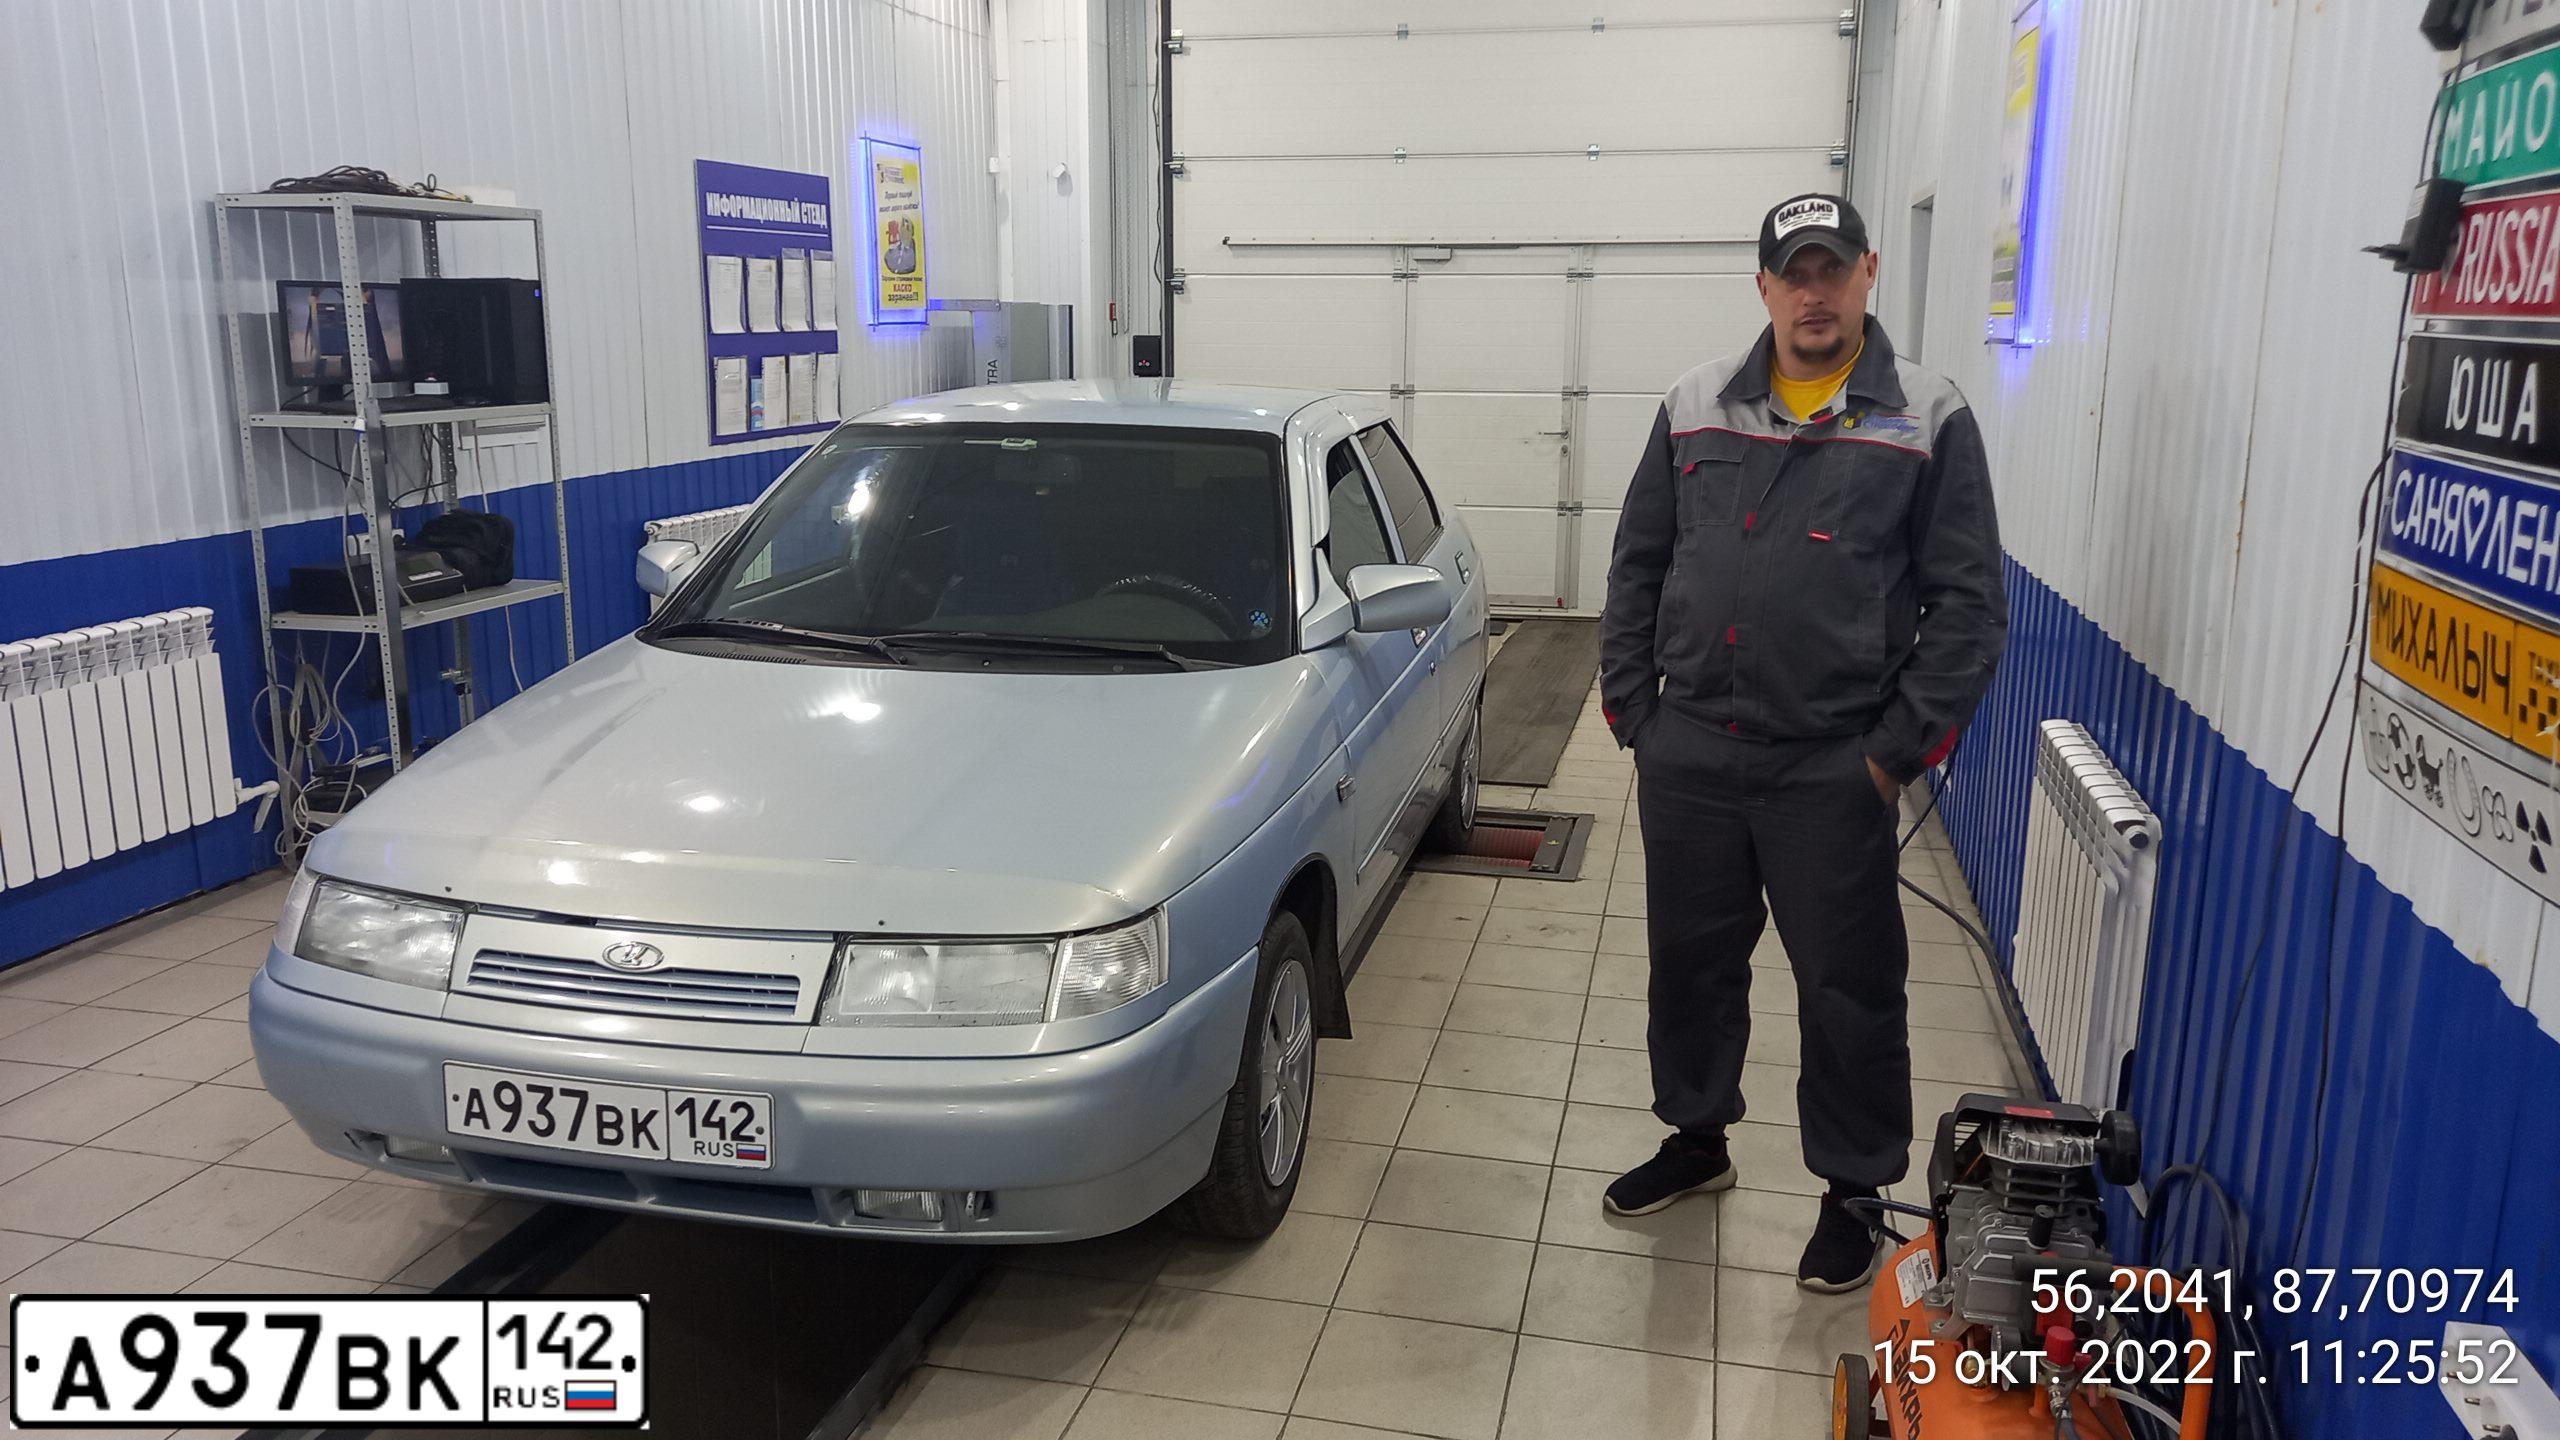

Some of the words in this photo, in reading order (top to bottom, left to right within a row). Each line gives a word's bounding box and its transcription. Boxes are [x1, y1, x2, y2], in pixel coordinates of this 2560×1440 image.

[2439, 71, 2560, 177] МАЙО
[706, 192, 801, 224] ИНФОРМАЦИОННЫЙ
[801, 201, 828, 229] СТЕНД
[1778, 202, 1833, 223] OAKLAND
[893, 284, 912, 292] КАСКО
[2455, 204, 2560, 304] RUSSIA
[2445, 354, 2539, 445] ЮША
[2374, 582, 2512, 716] МИХАЛЫЧ
[463, 1080, 661, 1151] А937ВК
[674, 1097, 757, 1143] 142
[693, 1141, 735, 1158] RUS
